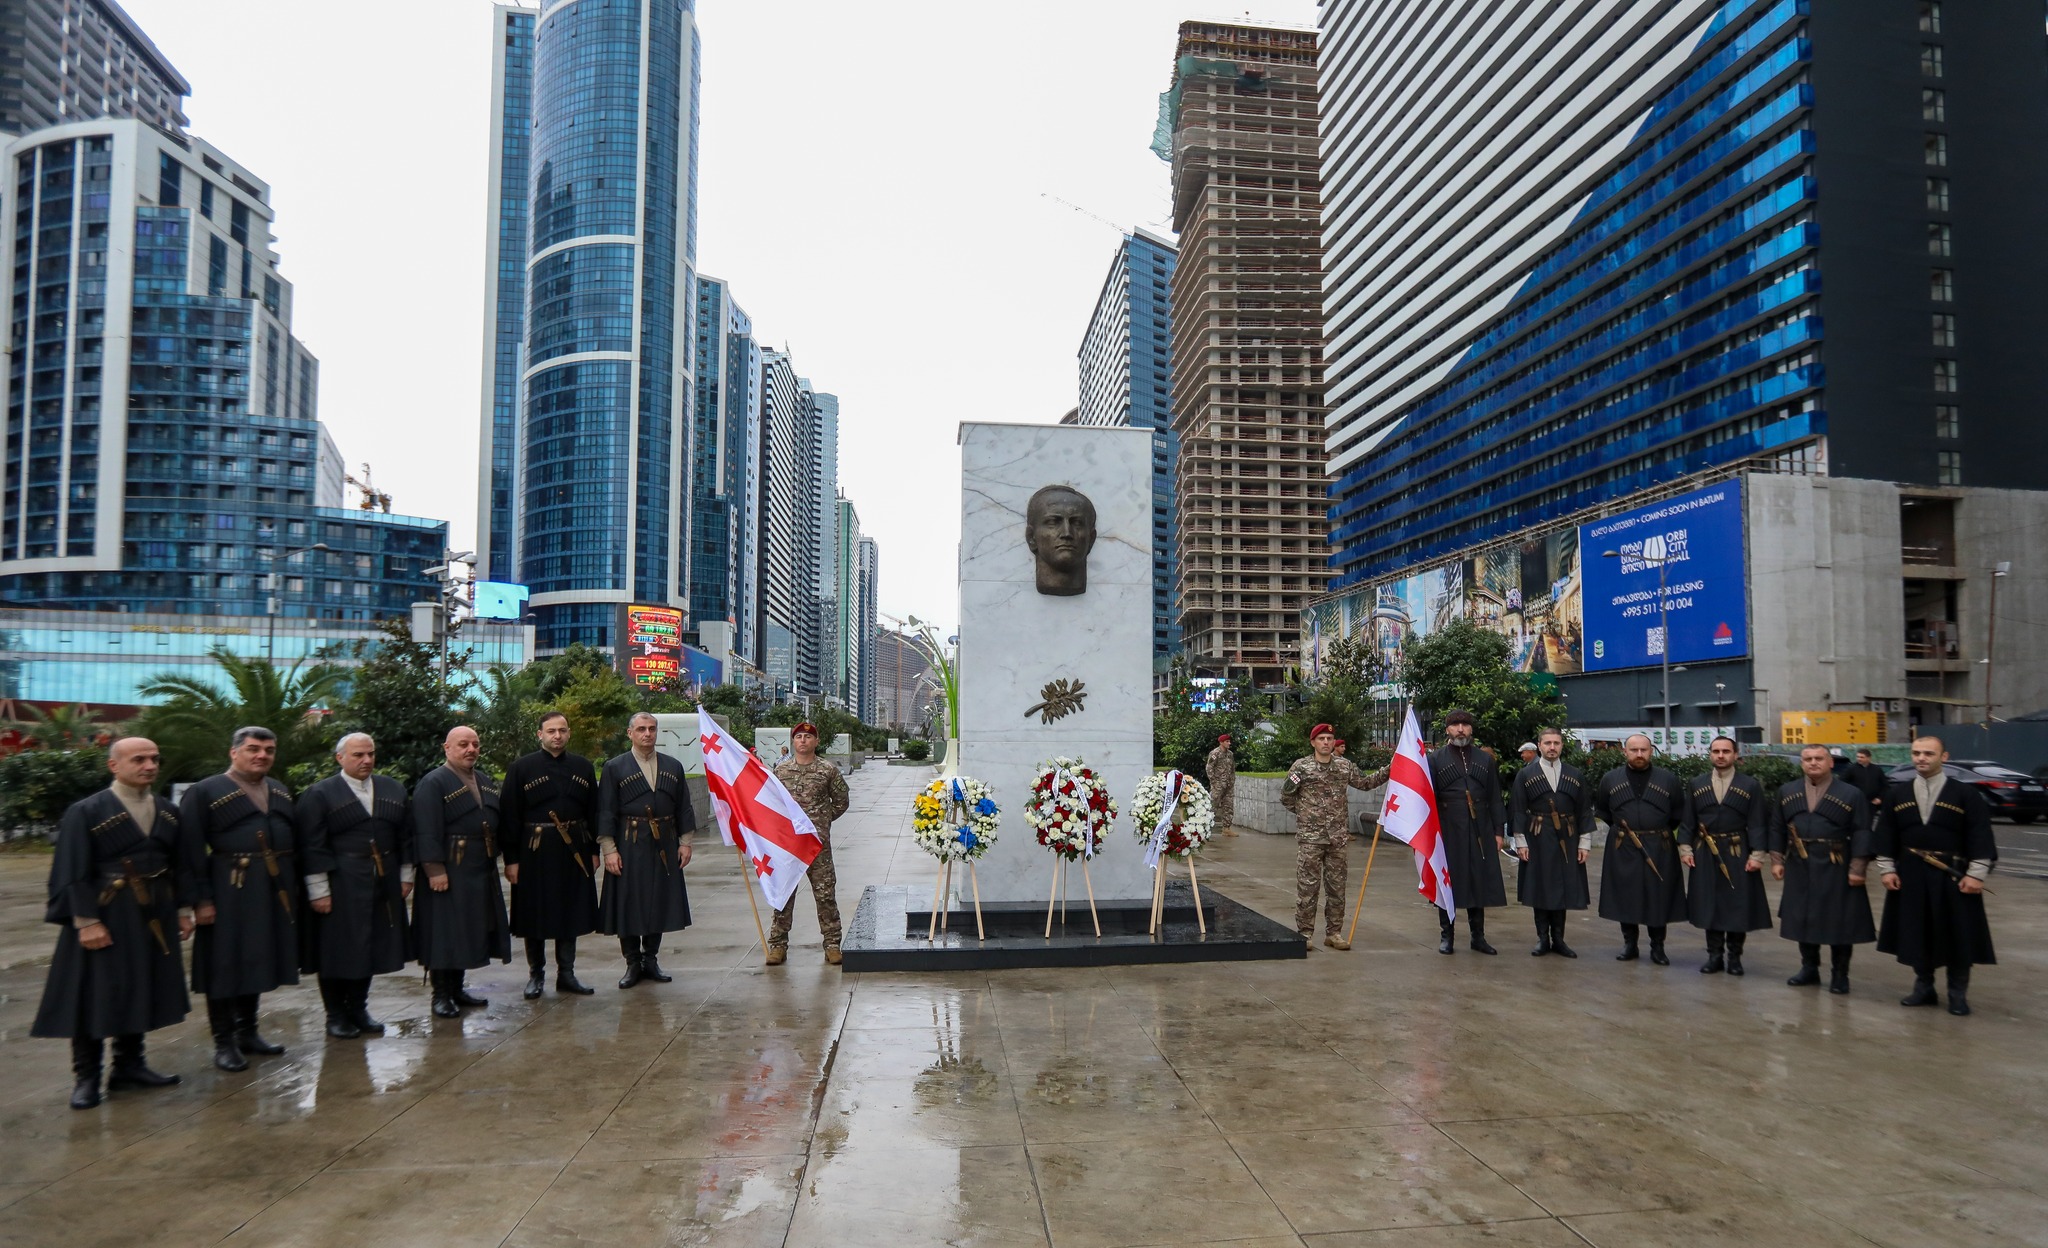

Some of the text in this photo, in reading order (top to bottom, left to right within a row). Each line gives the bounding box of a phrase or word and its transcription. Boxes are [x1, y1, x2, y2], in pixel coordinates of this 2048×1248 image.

[1641, 492, 1725, 523] COMING SOON IN BATUMI
[1666, 529, 1687, 542] ORBI
[1668, 540, 1688, 552] CITY
[1667, 550, 1690, 564] MALL
[1672, 580, 1704, 595] LEASING
[1622, 605, 1641, 617] +995
[1643, 602, 1657, 615] 511
[1676, 597, 1693, 609] 004
[645, 660, 656, 668] 130
